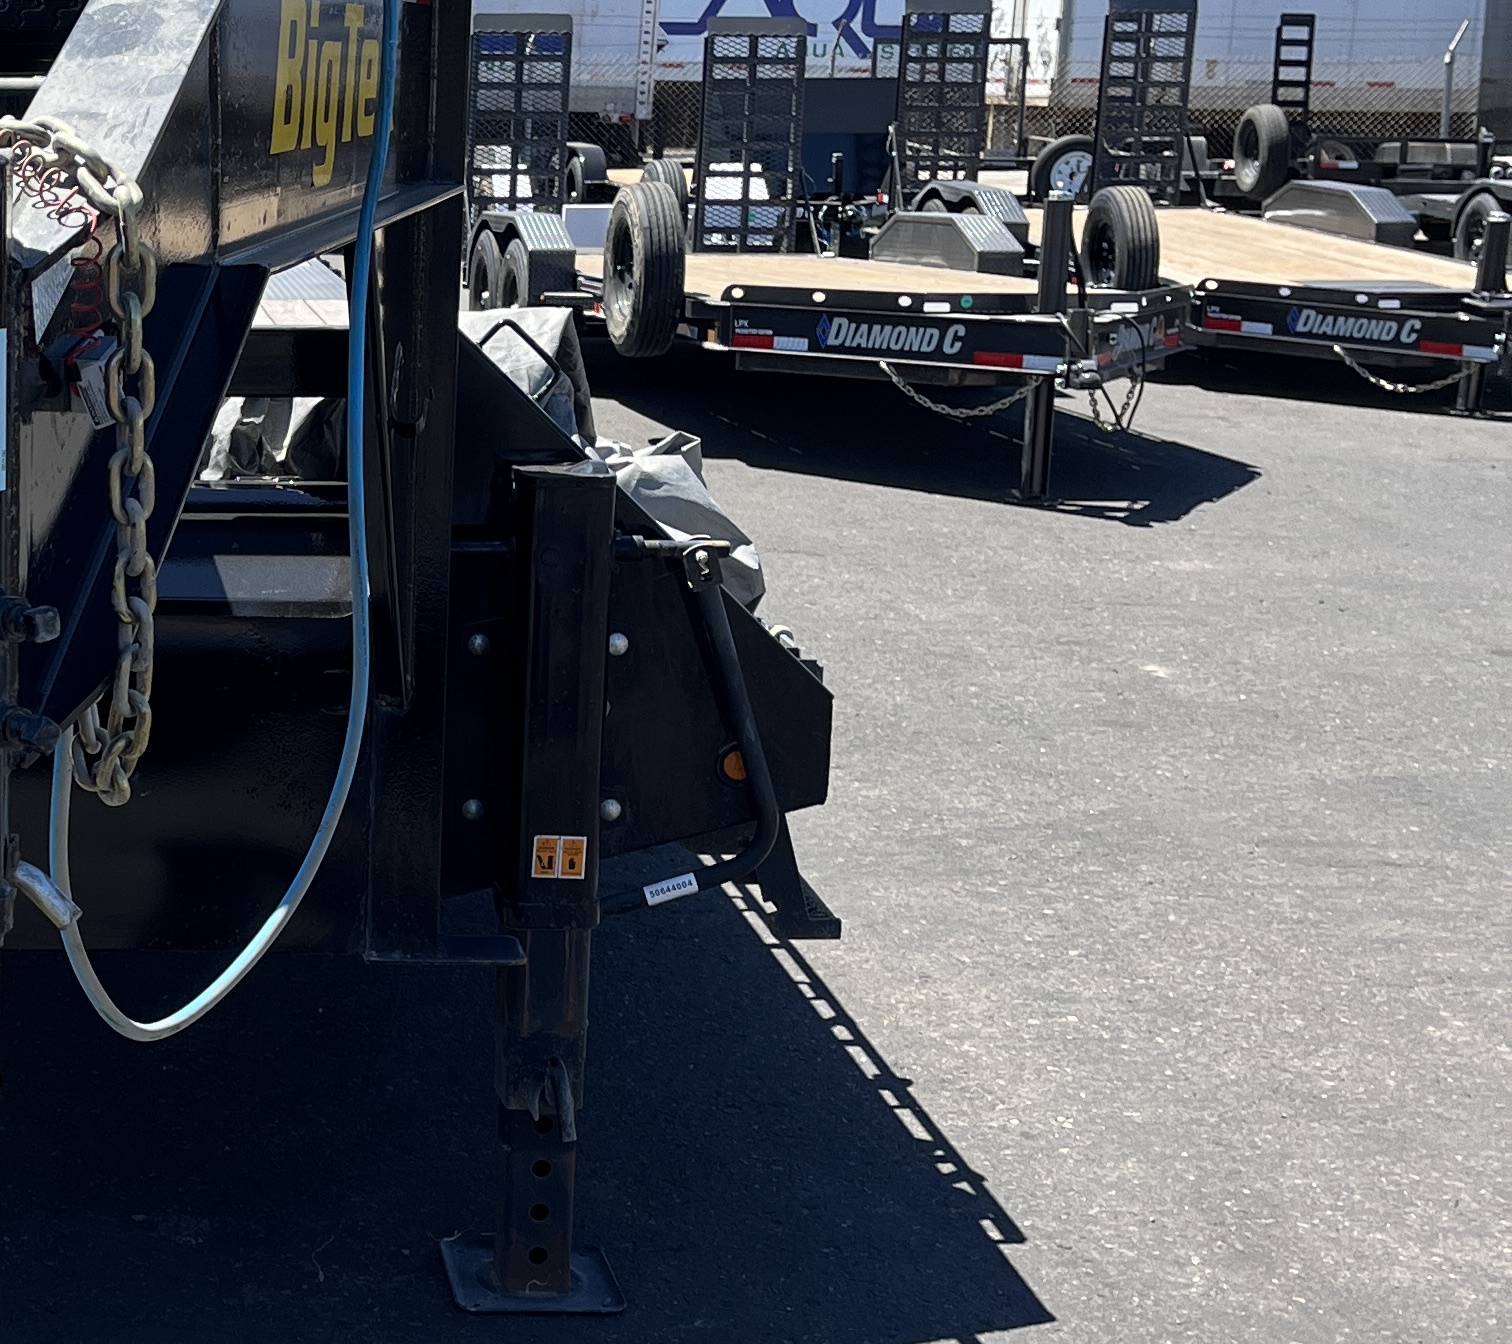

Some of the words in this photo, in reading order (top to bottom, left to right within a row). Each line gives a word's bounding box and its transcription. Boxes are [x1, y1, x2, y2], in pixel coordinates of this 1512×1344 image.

[826, 316, 939, 353] DIAMOND
[942, 323, 966, 355] C
[1295, 308, 1399, 342] DIAMOND
[1400, 318, 1422, 344] C
